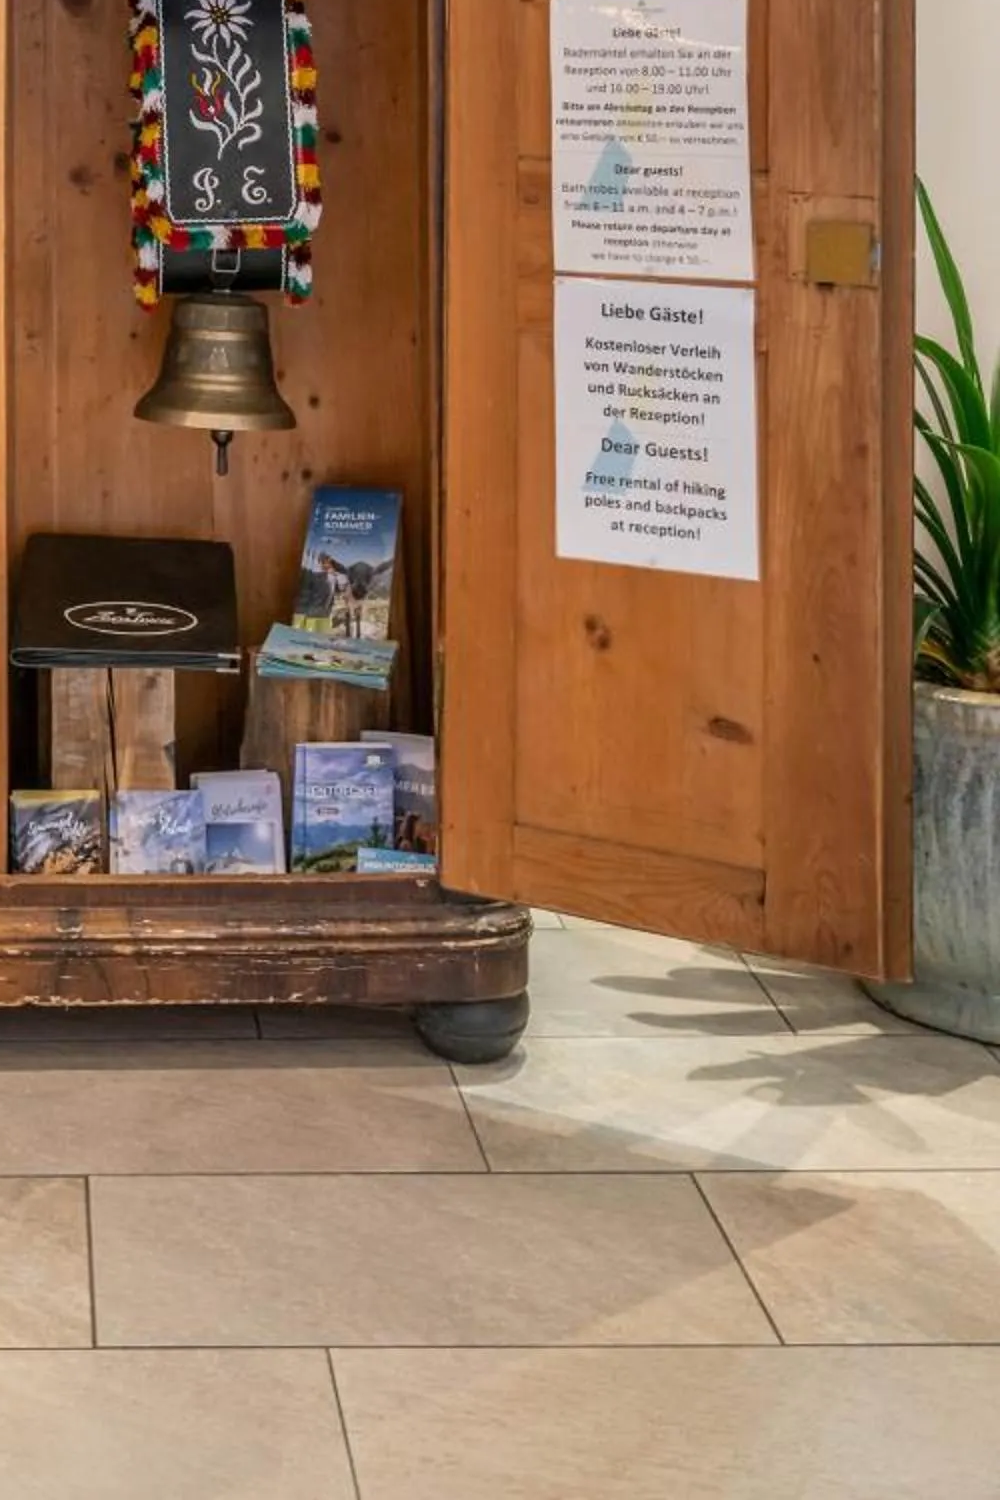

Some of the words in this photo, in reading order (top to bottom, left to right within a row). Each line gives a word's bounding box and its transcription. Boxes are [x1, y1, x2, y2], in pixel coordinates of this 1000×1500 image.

[612, 27, 641, 39] Liebe
[697, 51, 711, 59] an
[713, 49, 731, 60] der
[619, 68, 639, 76] von
[711, 66, 731, 77] Uhr
[586, 83, 607, 93] und
[614, 163, 641, 175] Dear
[643, 165, 683, 177] guests!
[622, 185, 669, 197] available
[672, 187, 683, 197] at
[686, 187, 740, 200] reception
[571, 220, 601, 231] Please
[604, 222, 633, 231] return
[701, 225, 719, 237] day
[721, 227, 731, 236] at
[601, 302, 644, 321] Liebe
[650, 305, 705, 325] Gäste!
[585, 337, 666, 357] Kostenloser
[670, 343, 722, 360] Verleih
[584, 360, 609, 373] von
[613, 361, 724, 383] Wanderstöcken
[587, 382, 615, 396] und
[619, 383, 699, 404] Rucksäcken
[703, 393, 721, 405] an
[603, 404, 625, 419] der
[629, 406, 706, 426] Rezeption!
[600, 437, 640, 455] Dear
[645, 441, 709, 463] Guests!
[585, 471, 615, 488] Free
[619, 475, 661, 491] rental
[664, 478, 680, 493] of
[683, 481, 726, 501] hiking
[584, 494, 621, 511] poles
[625, 498, 651, 513] and
[655, 500, 728, 522] backpacks
[610, 518, 625, 533] at
[629, 520, 701, 542] reception!
